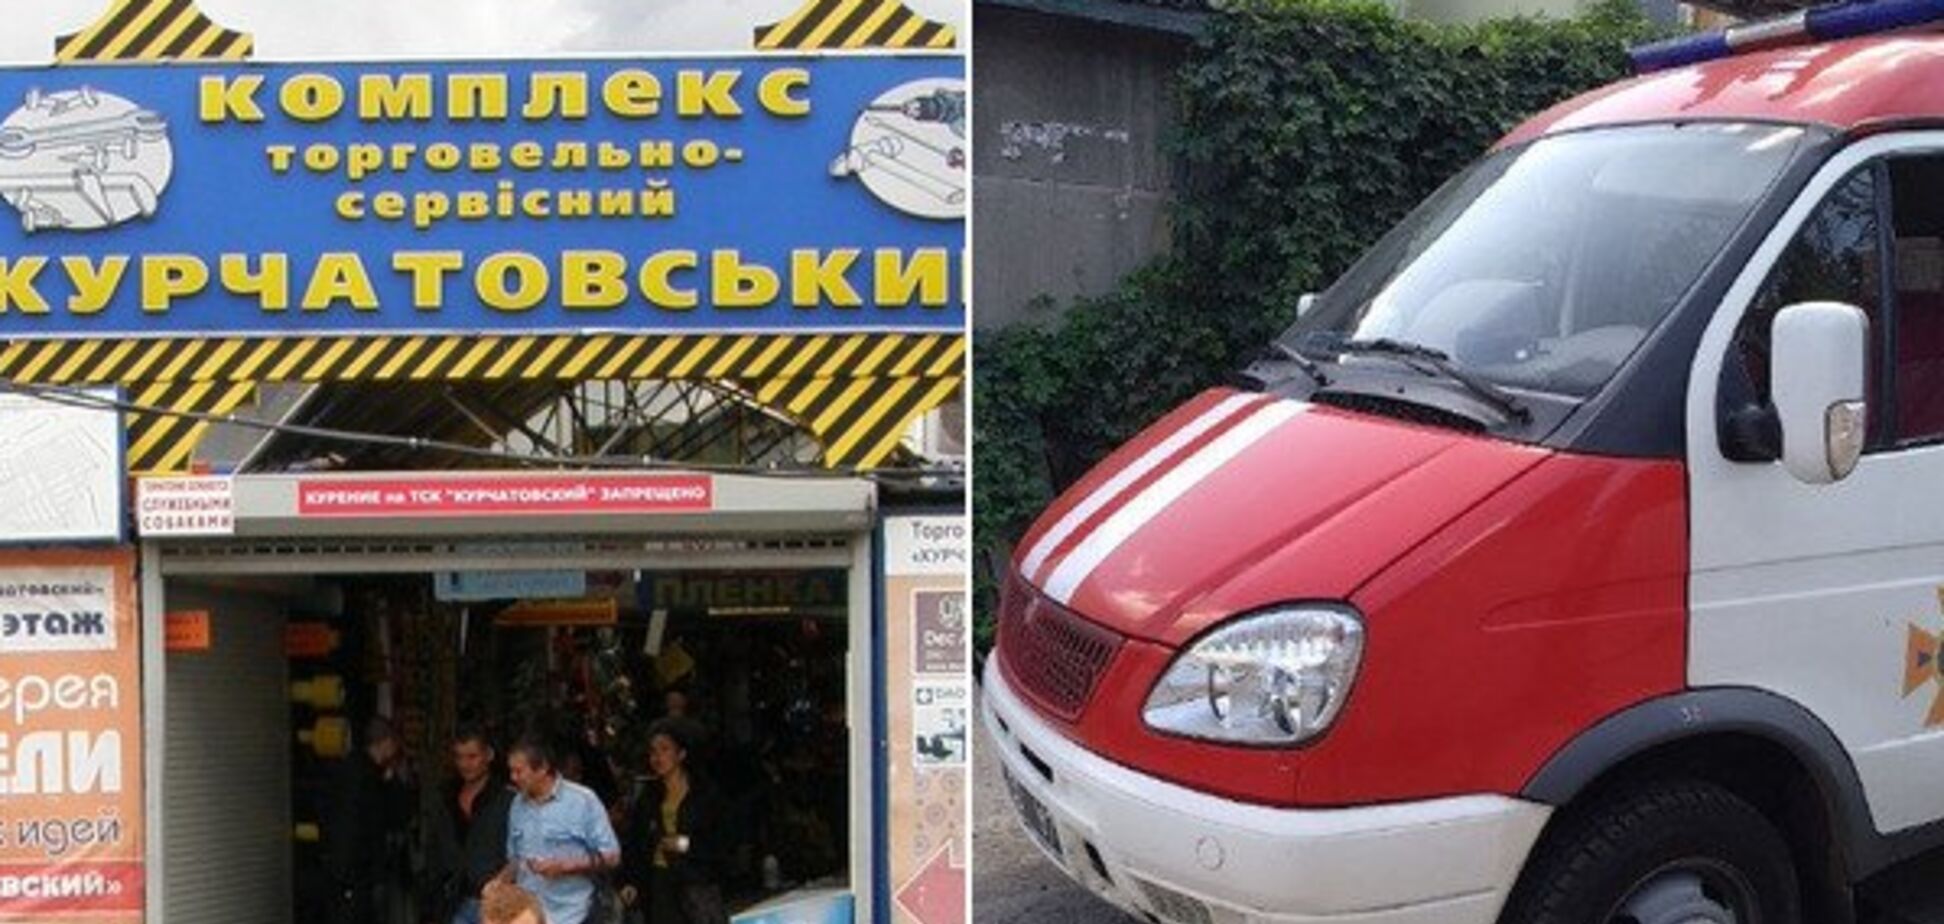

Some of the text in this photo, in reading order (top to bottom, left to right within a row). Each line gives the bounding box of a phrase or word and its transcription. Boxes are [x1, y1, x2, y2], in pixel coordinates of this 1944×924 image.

[266, 138, 743, 179] торговельно-
[336, 178, 675, 227] сервісний
[0, 247, 965, 313] КУРЧАТОВСЬКИ
[305, 490, 381, 504] КУРЕНИЕ
[385, 492, 406, 503] на
[410, 489, 442, 503] ТСК
[601, 486, 706, 502] ЗАПРЕЩЕНО
[143, 516, 231, 530] СОБАКАМИ
[0, 729, 121, 794] ЛИ
